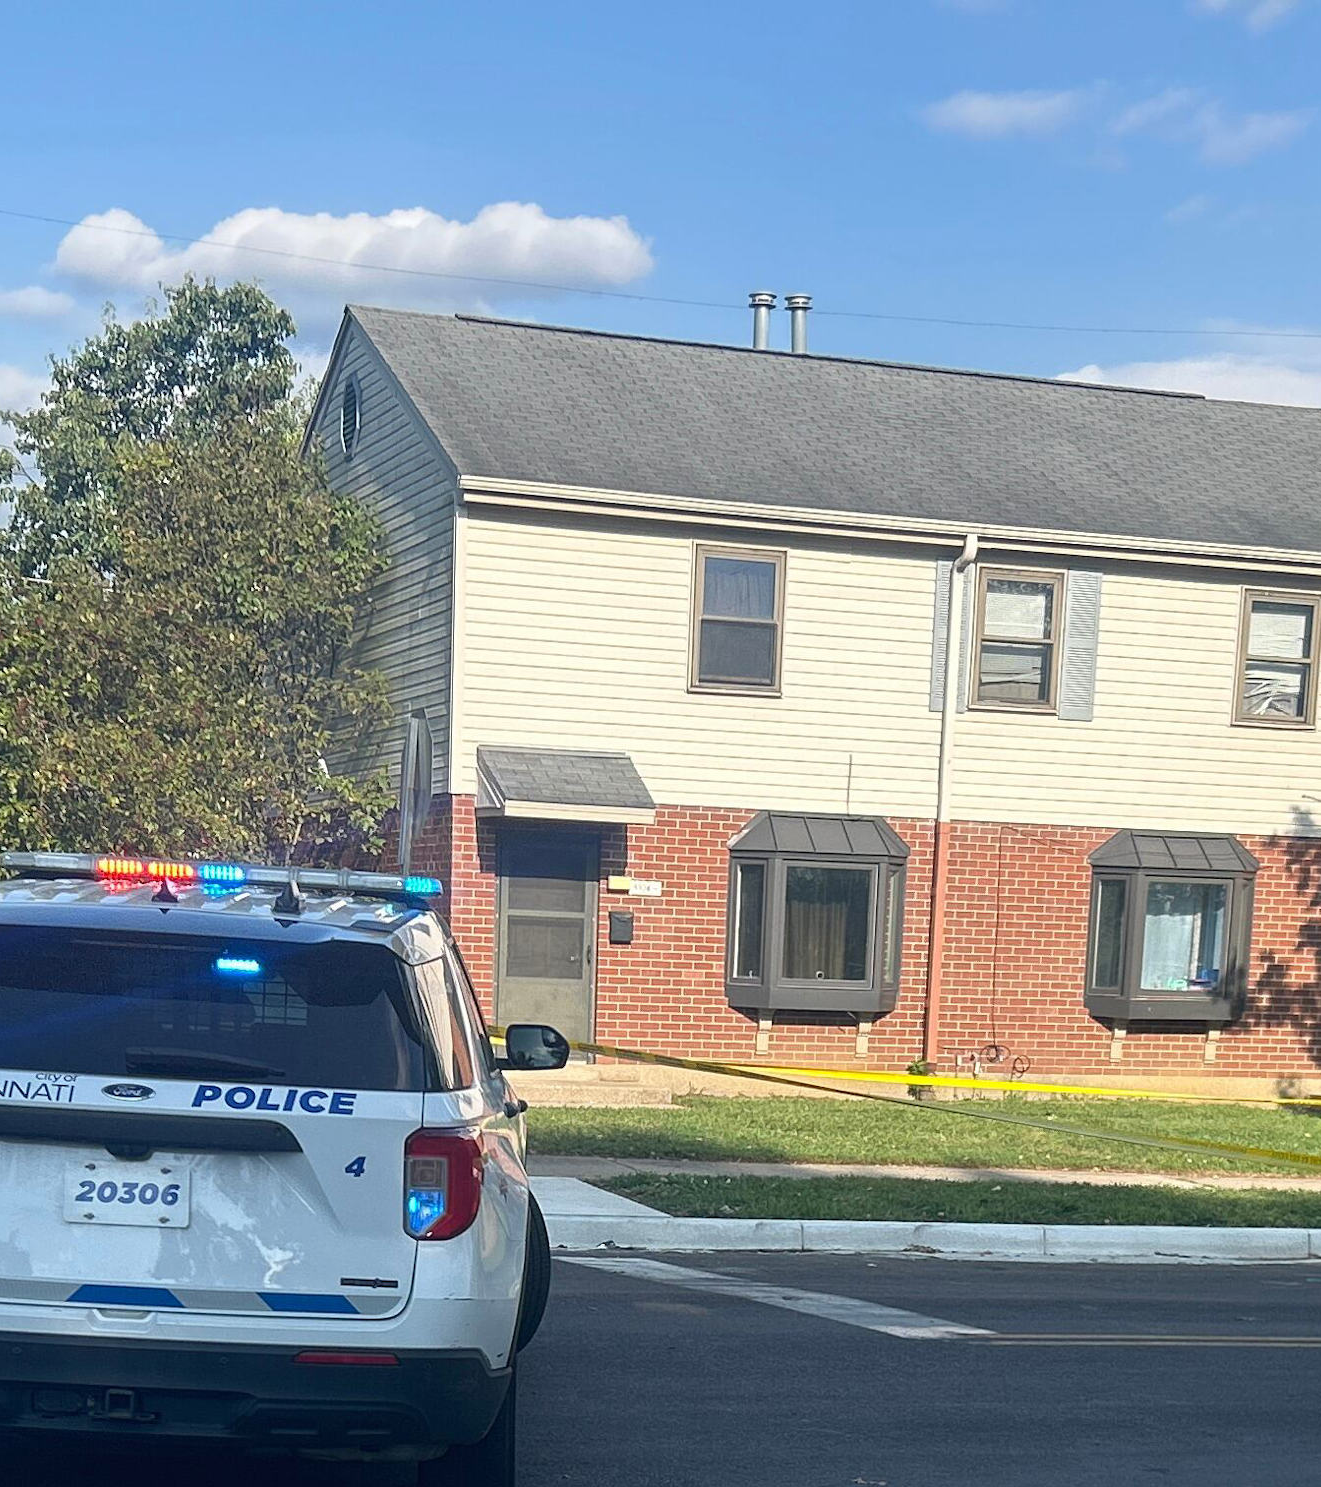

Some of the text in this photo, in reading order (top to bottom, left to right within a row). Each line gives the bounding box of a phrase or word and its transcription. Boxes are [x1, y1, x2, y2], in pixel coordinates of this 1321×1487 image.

[191, 1084, 358, 1116] POLICE
[344, 1156, 367, 1178] 4
[74, 1180, 181, 1206] 20306
